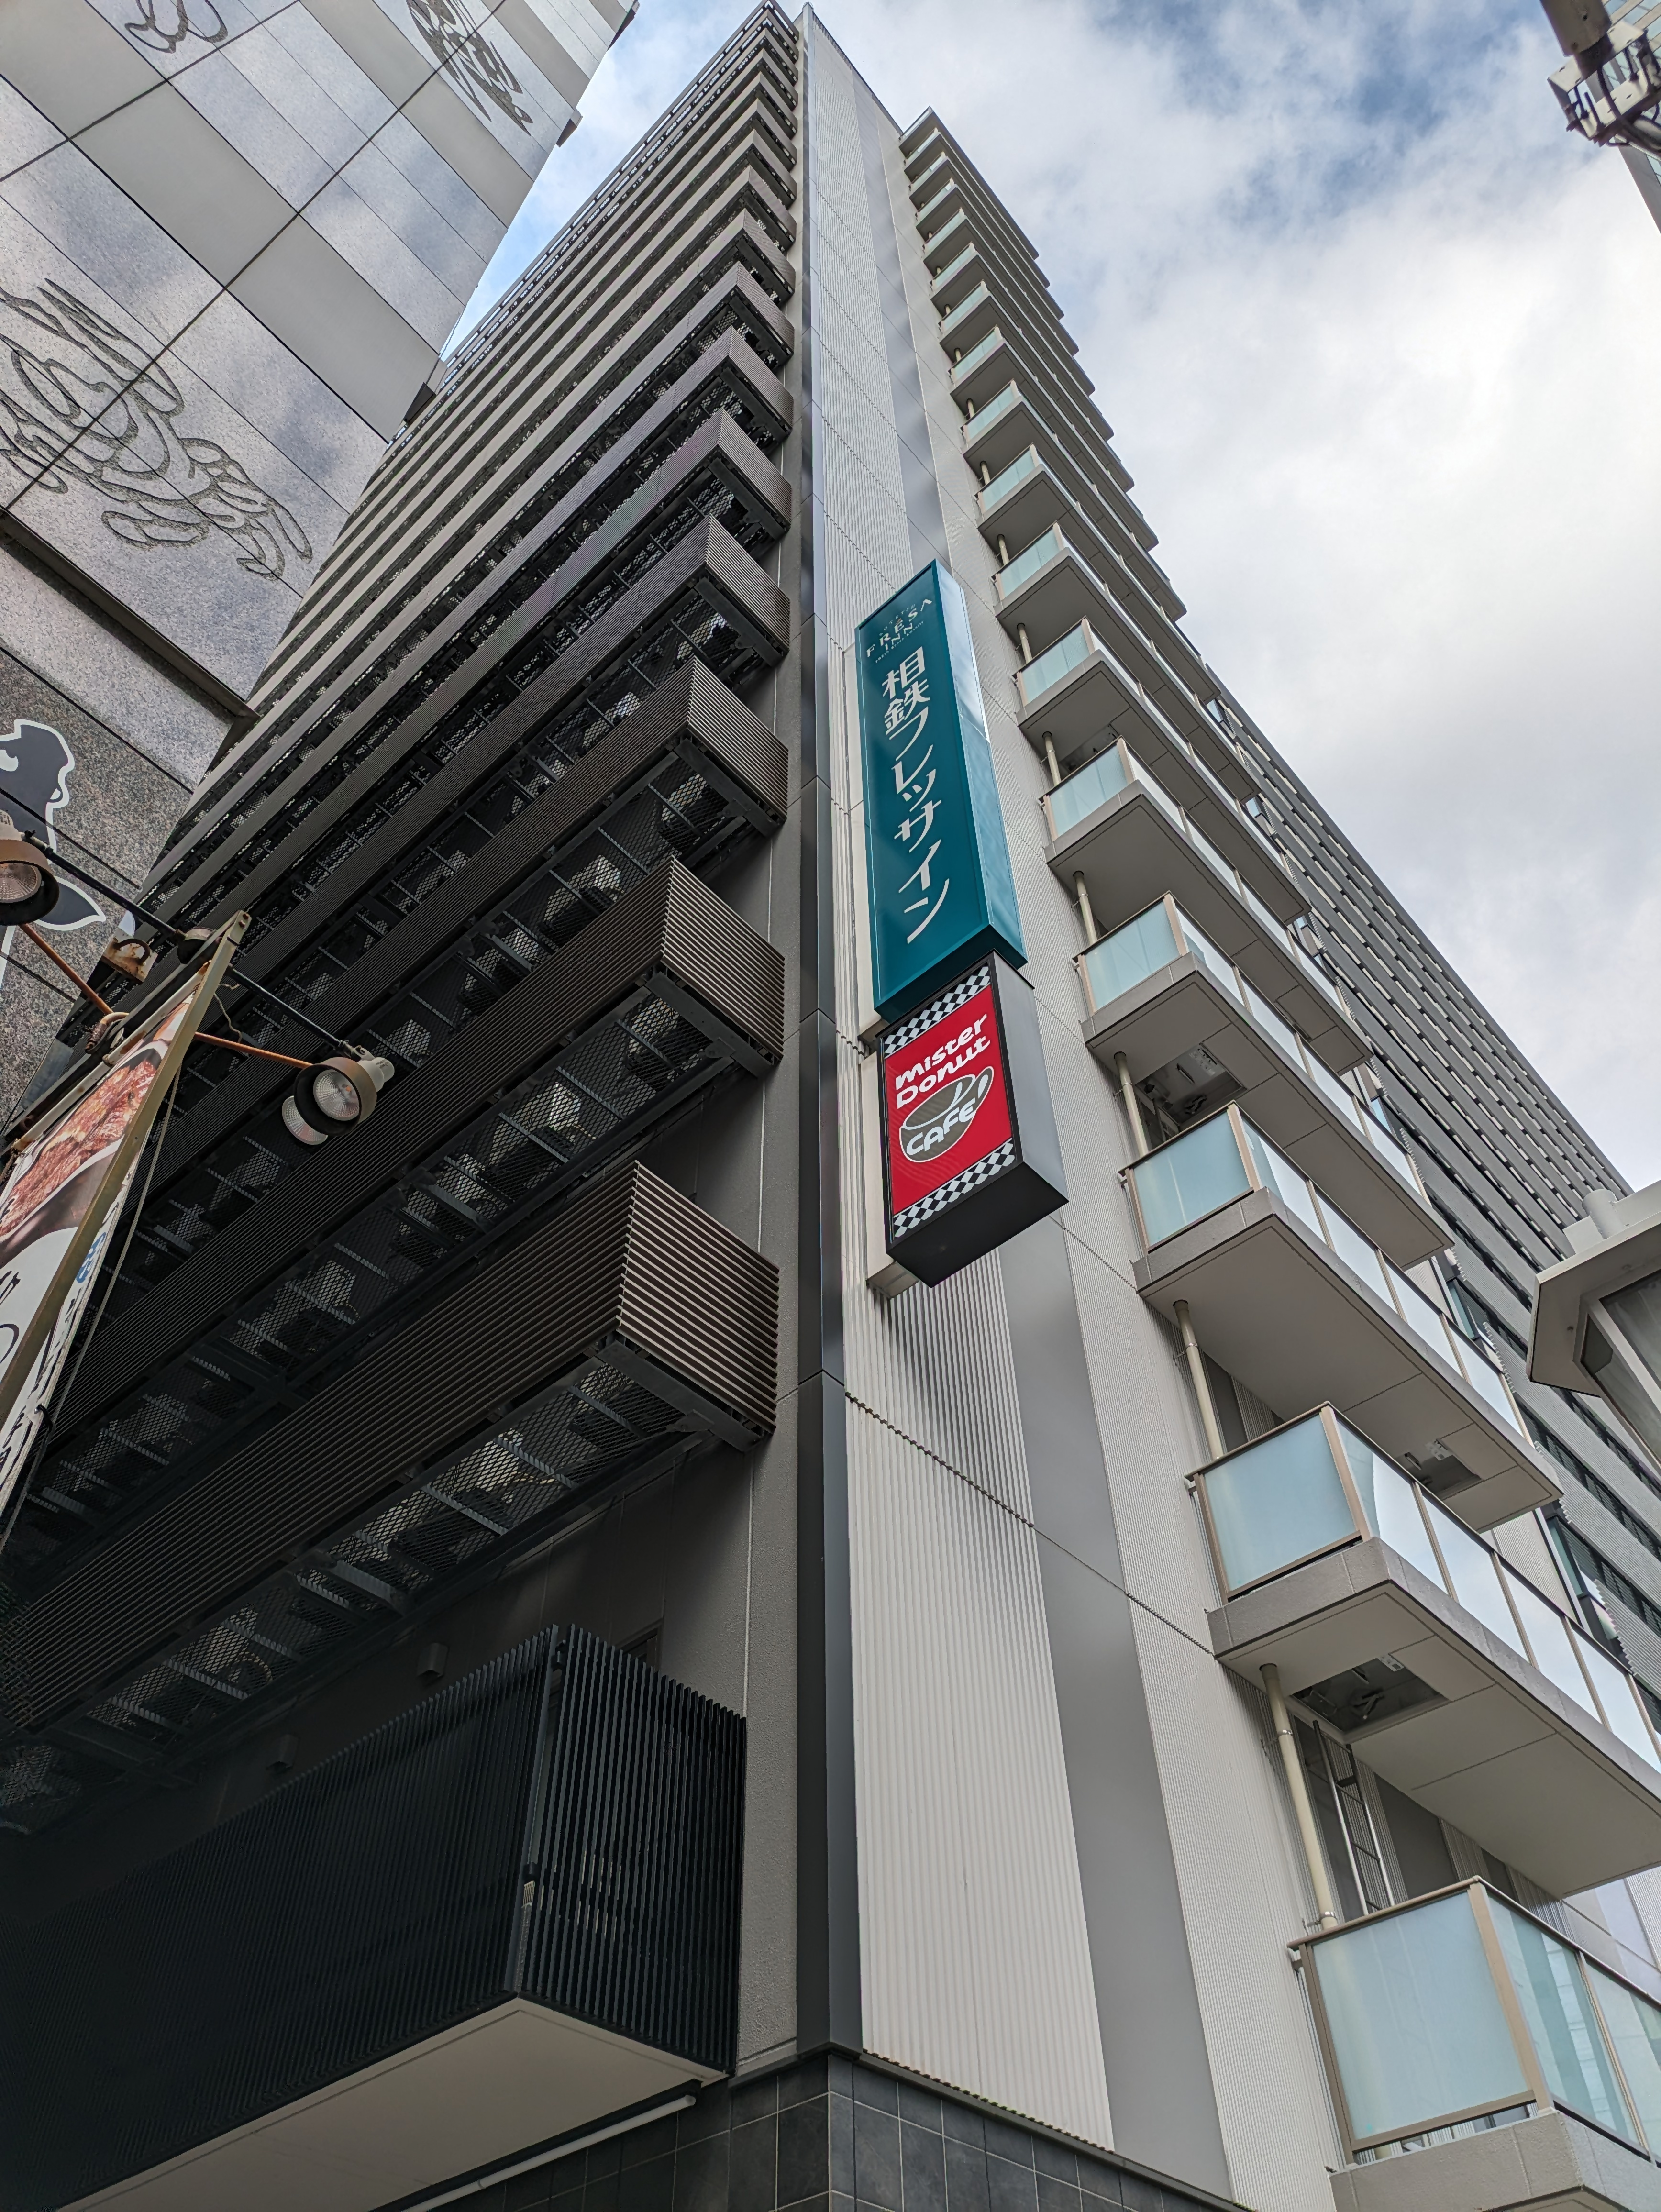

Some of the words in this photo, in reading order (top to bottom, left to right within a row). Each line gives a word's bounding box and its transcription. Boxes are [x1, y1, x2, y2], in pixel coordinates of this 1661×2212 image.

[885, 622, 913, 651] INN
[881, 646, 950, 944] 相鉄フレッサイン
[896, 1036, 991, 1109] Donut
